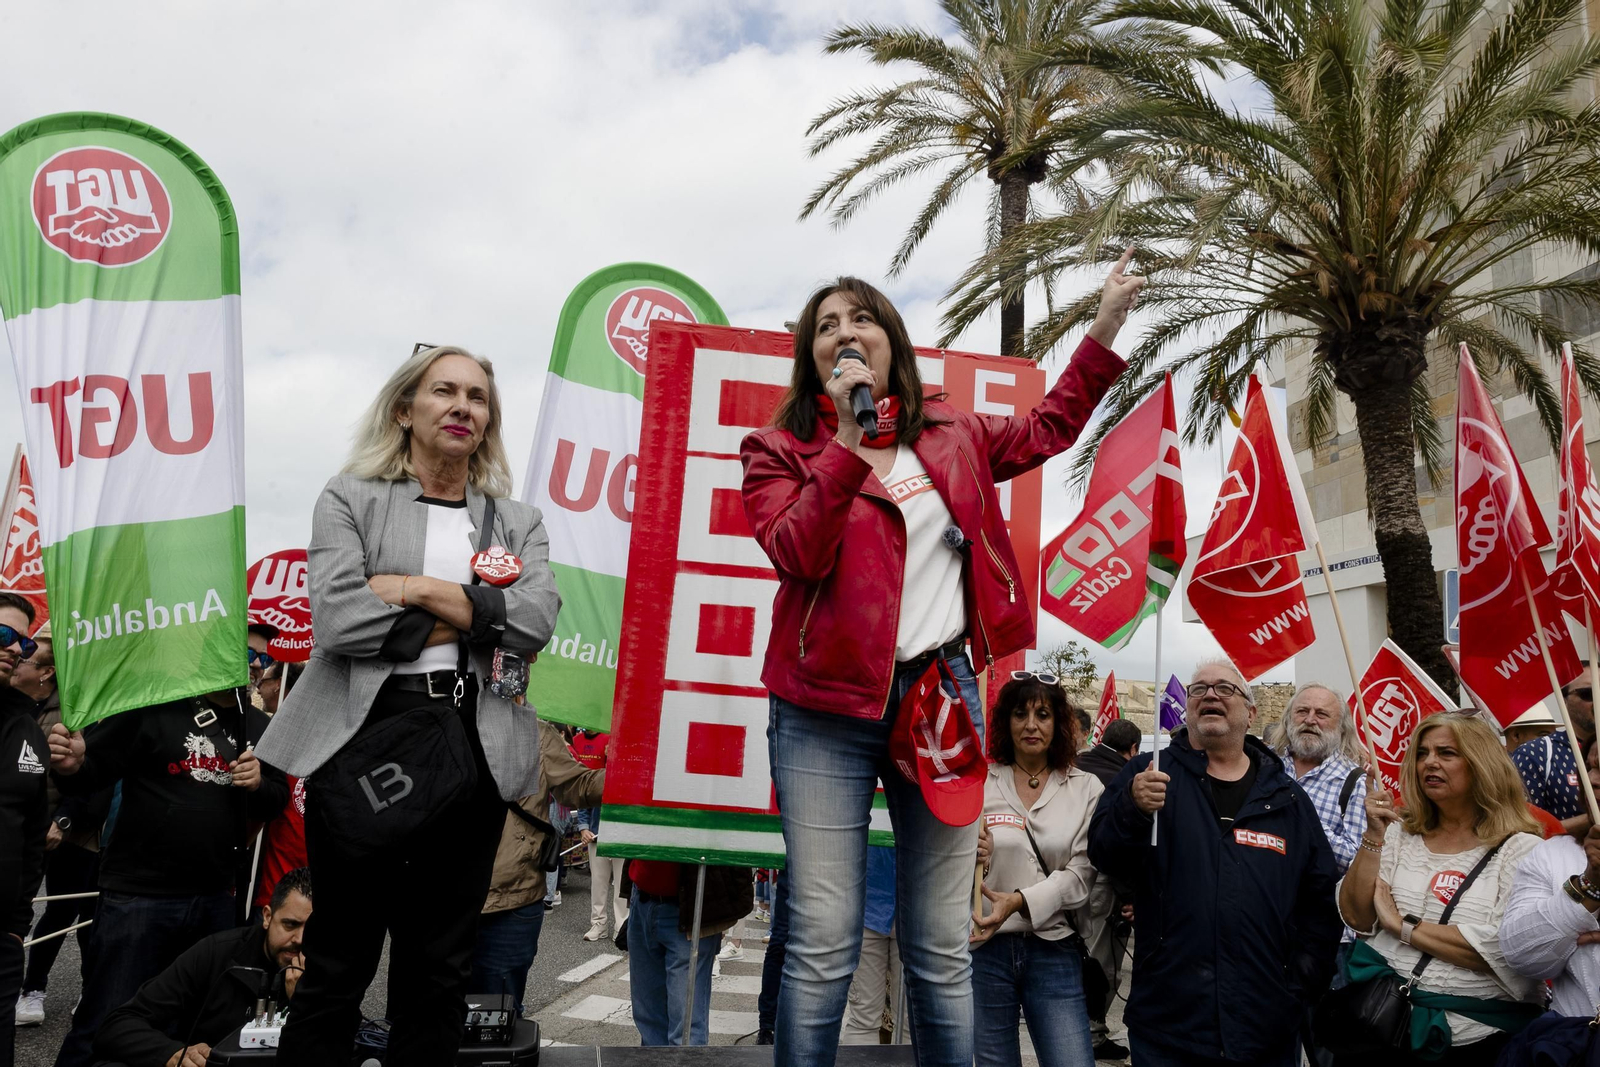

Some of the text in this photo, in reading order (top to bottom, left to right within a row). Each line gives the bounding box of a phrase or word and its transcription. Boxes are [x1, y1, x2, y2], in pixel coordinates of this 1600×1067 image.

[548, 438, 638, 523] UG
[252, 558, 310, 600] UG
[1360, 682, 1406, 750] UGT
[984, 815, 1015, 825] COO
[1236, 830, 1277, 848] CCOO
